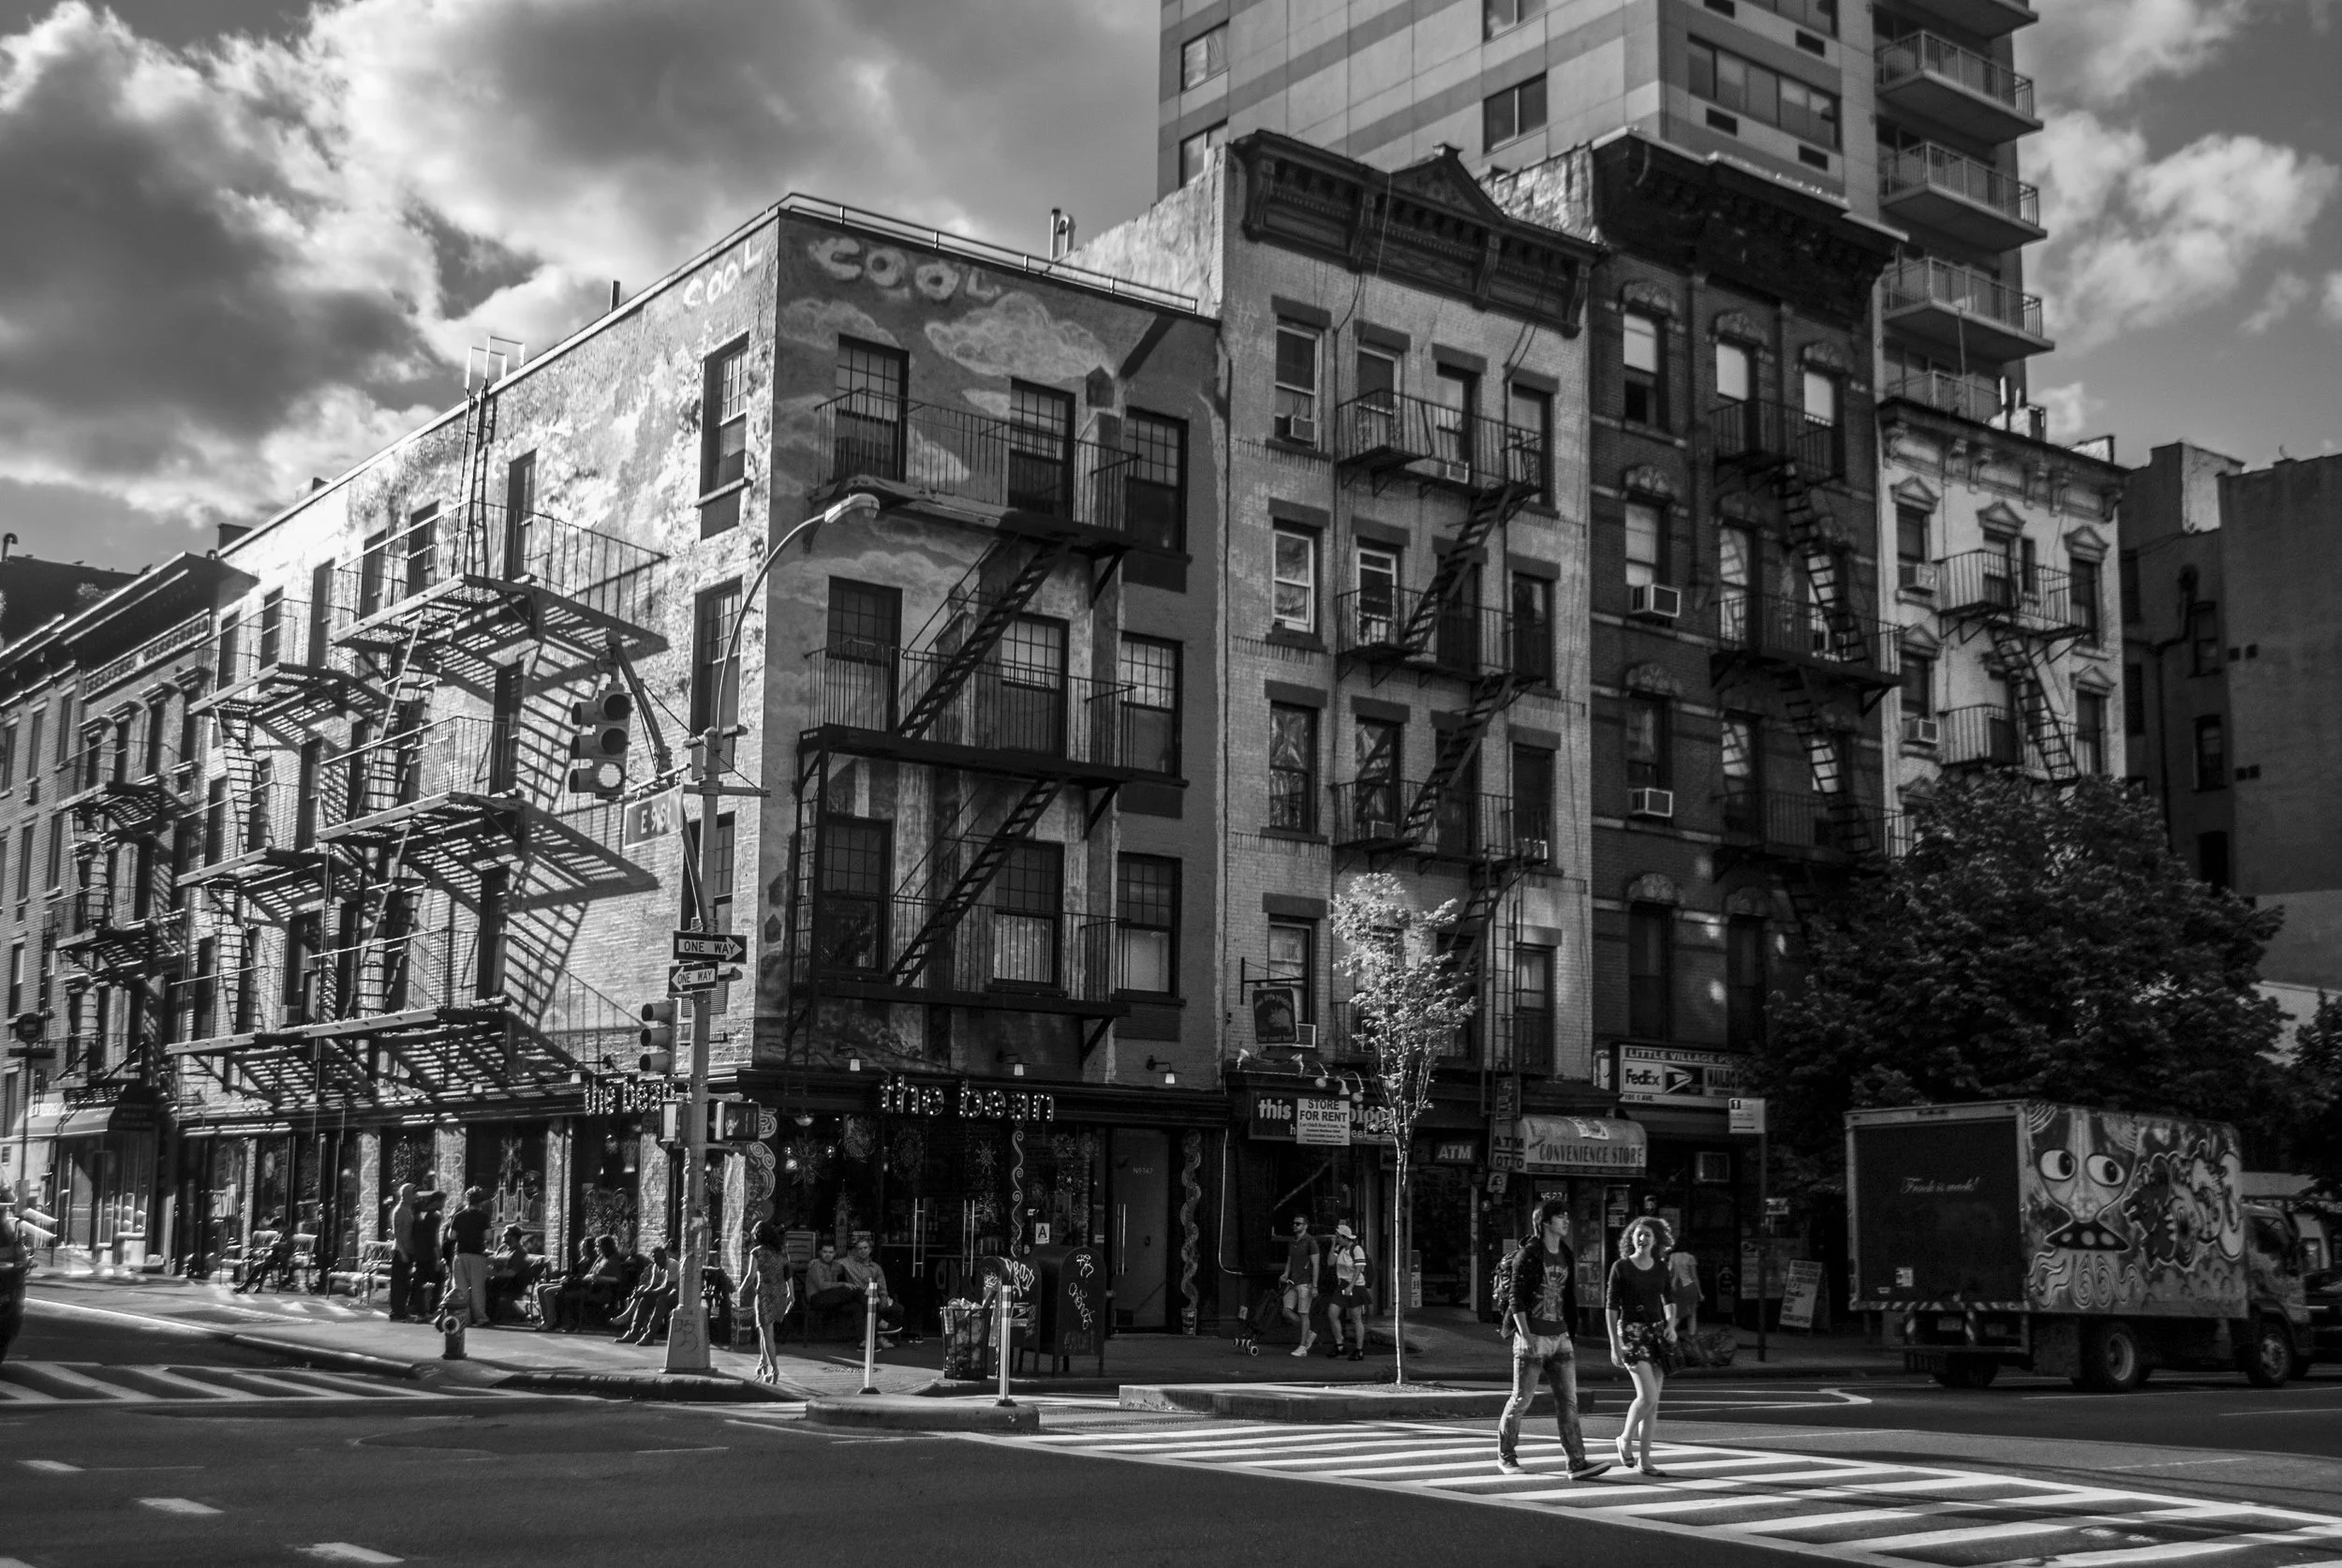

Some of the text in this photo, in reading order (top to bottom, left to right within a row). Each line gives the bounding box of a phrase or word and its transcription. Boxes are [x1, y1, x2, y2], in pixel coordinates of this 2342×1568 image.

[683, 242, 761, 307] COOL
[808, 236, 1001, 302] COOL
[641, 809, 648, 835] E
[651, 806, 658, 832] 9
[684, 940, 735, 954] ONE WAY
[677, 969, 713, 984] ONE WAY
[1628, 1048, 1667, 1060] LITTLE
[1670, 1051, 1714, 1063] VILLAGE
[1625, 1068, 1660, 1086] FedEx
[584, 1075, 675, 1116] the bean
[879, 1073, 1054, 1122] the bean
[1257, 1098, 1292, 1120] this
[1308, 1099, 1340, 1110] STORE
[1299, 1110, 1347, 1122] FOR RENT
[1350, 1130, 1368, 1139] eef
[1437, 1145, 1473, 1160] ATM
[1539, 1144, 1642, 1164] CONVENIENCE STORE
[1495, 1156, 1523, 1169] OTO
[1037, 1225, 1047, 1238] A
